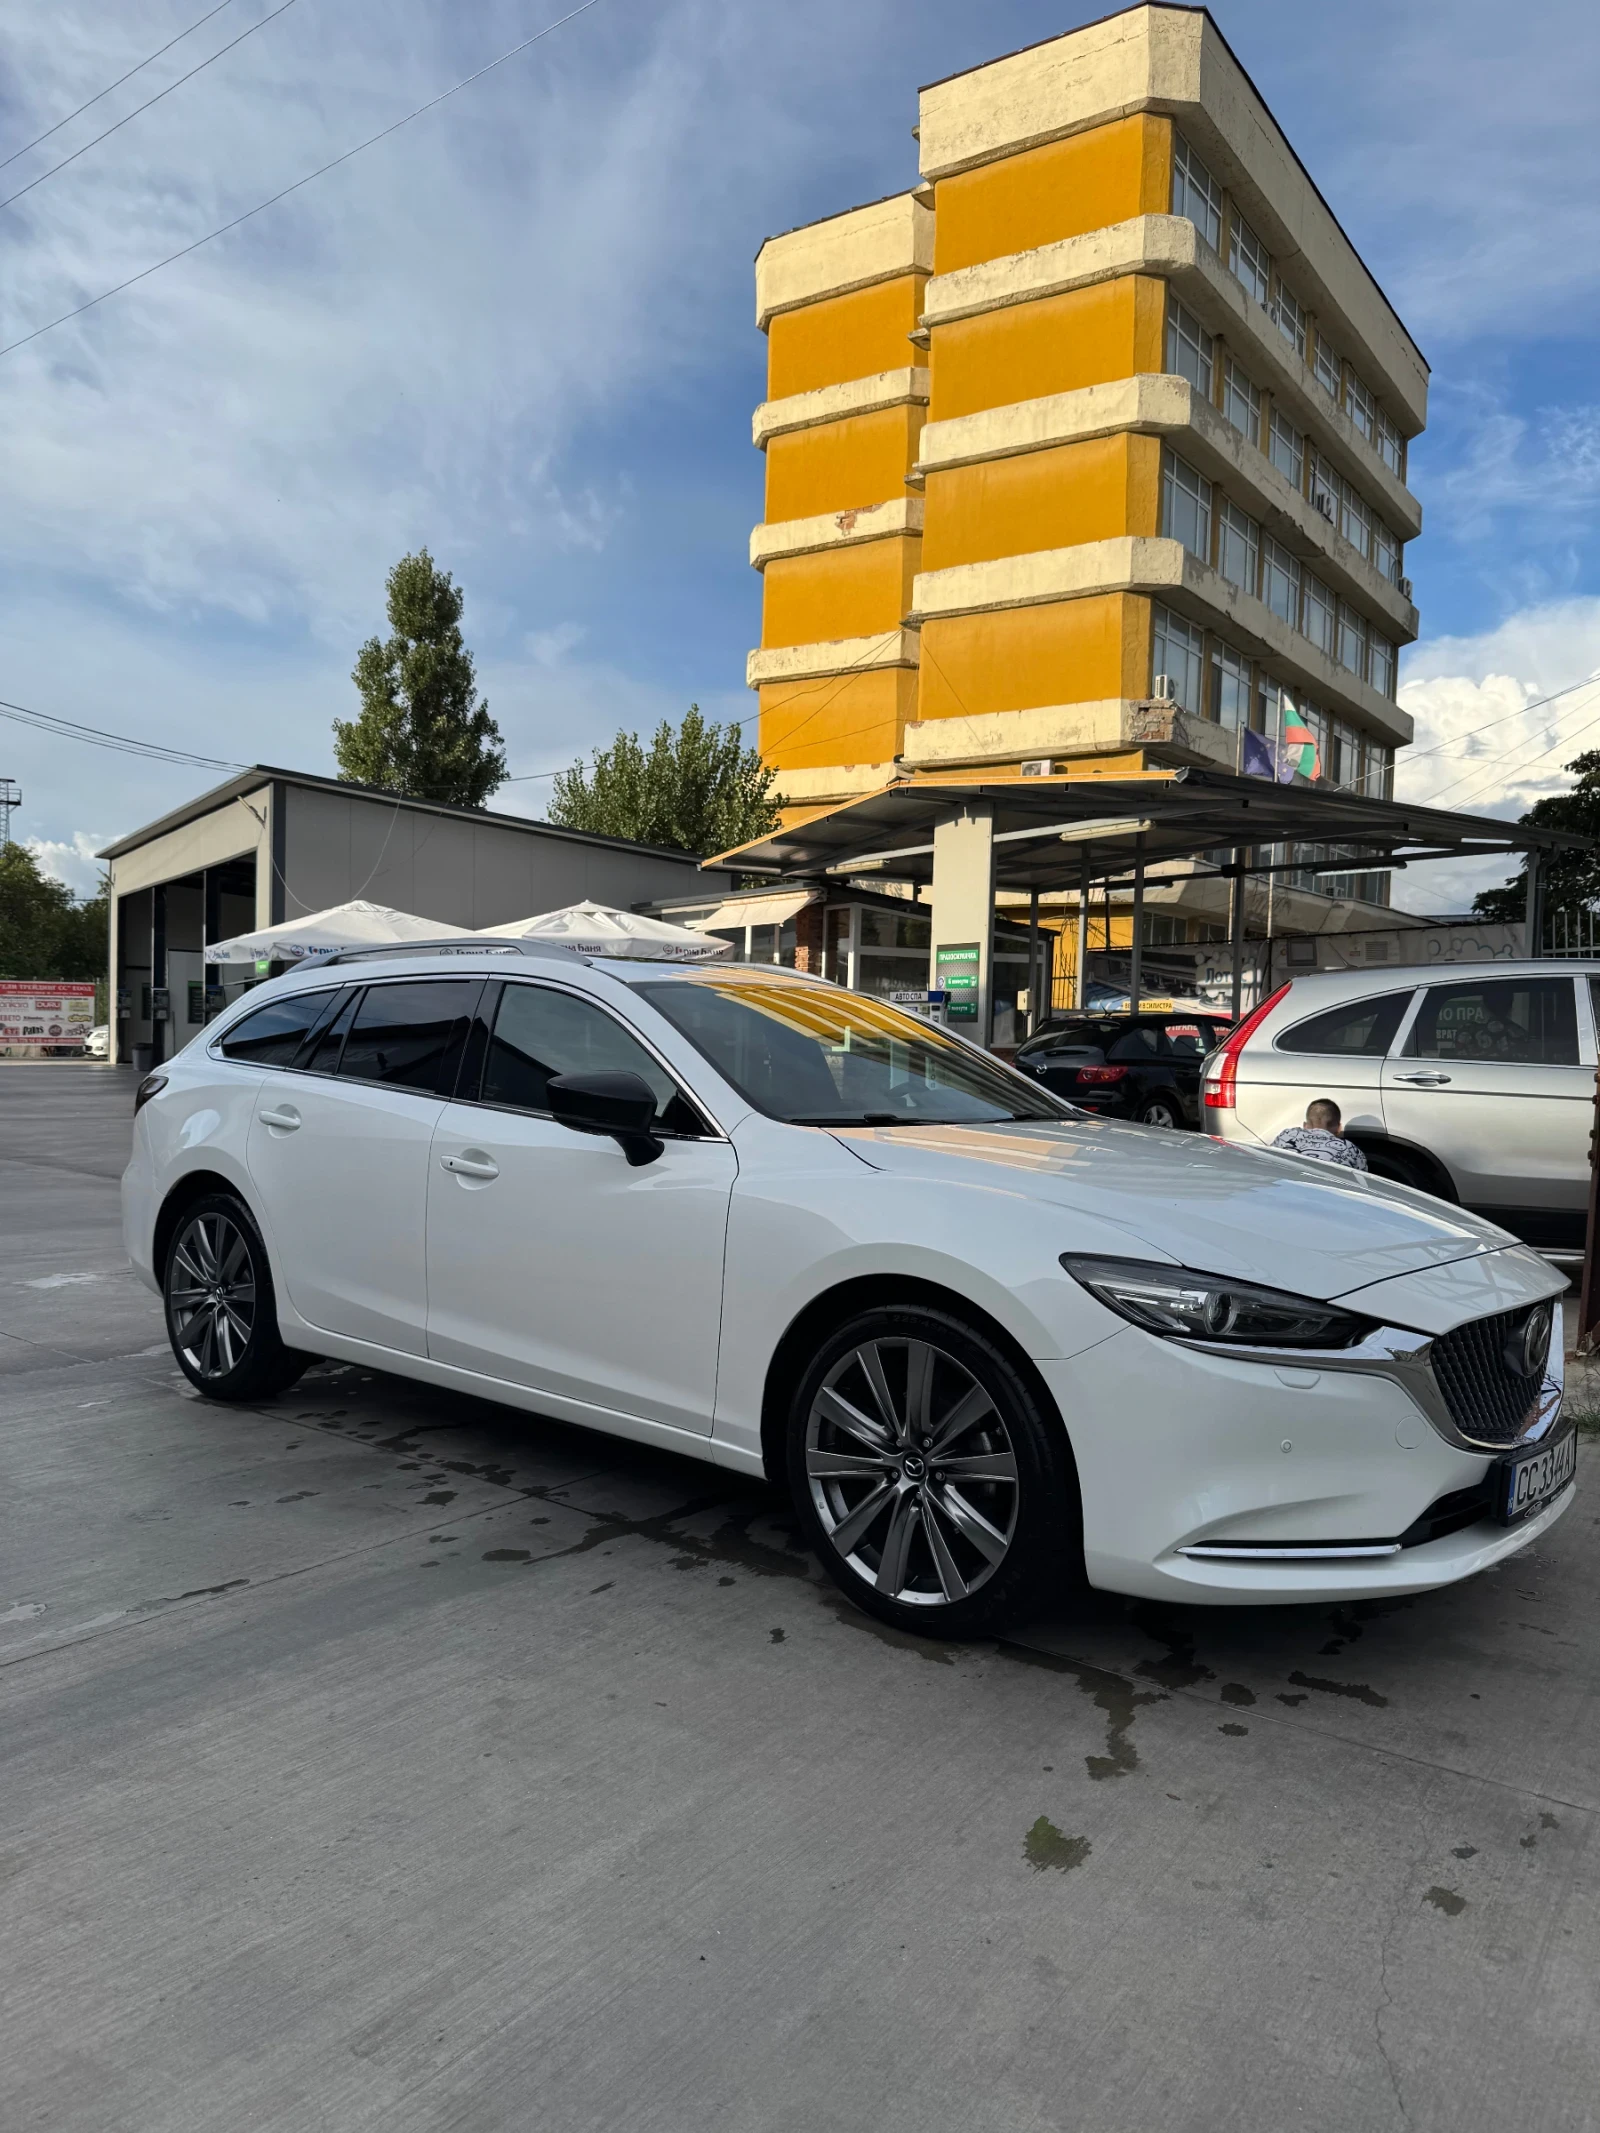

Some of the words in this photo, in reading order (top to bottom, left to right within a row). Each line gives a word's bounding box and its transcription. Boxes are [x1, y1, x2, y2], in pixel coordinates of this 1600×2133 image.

[577, 943, 601, 953] Баня
[1205, 967, 1247, 983] Лотс
[895, 992, 909, 1000] АВТО
[910, 992, 922, 1000] СПА
